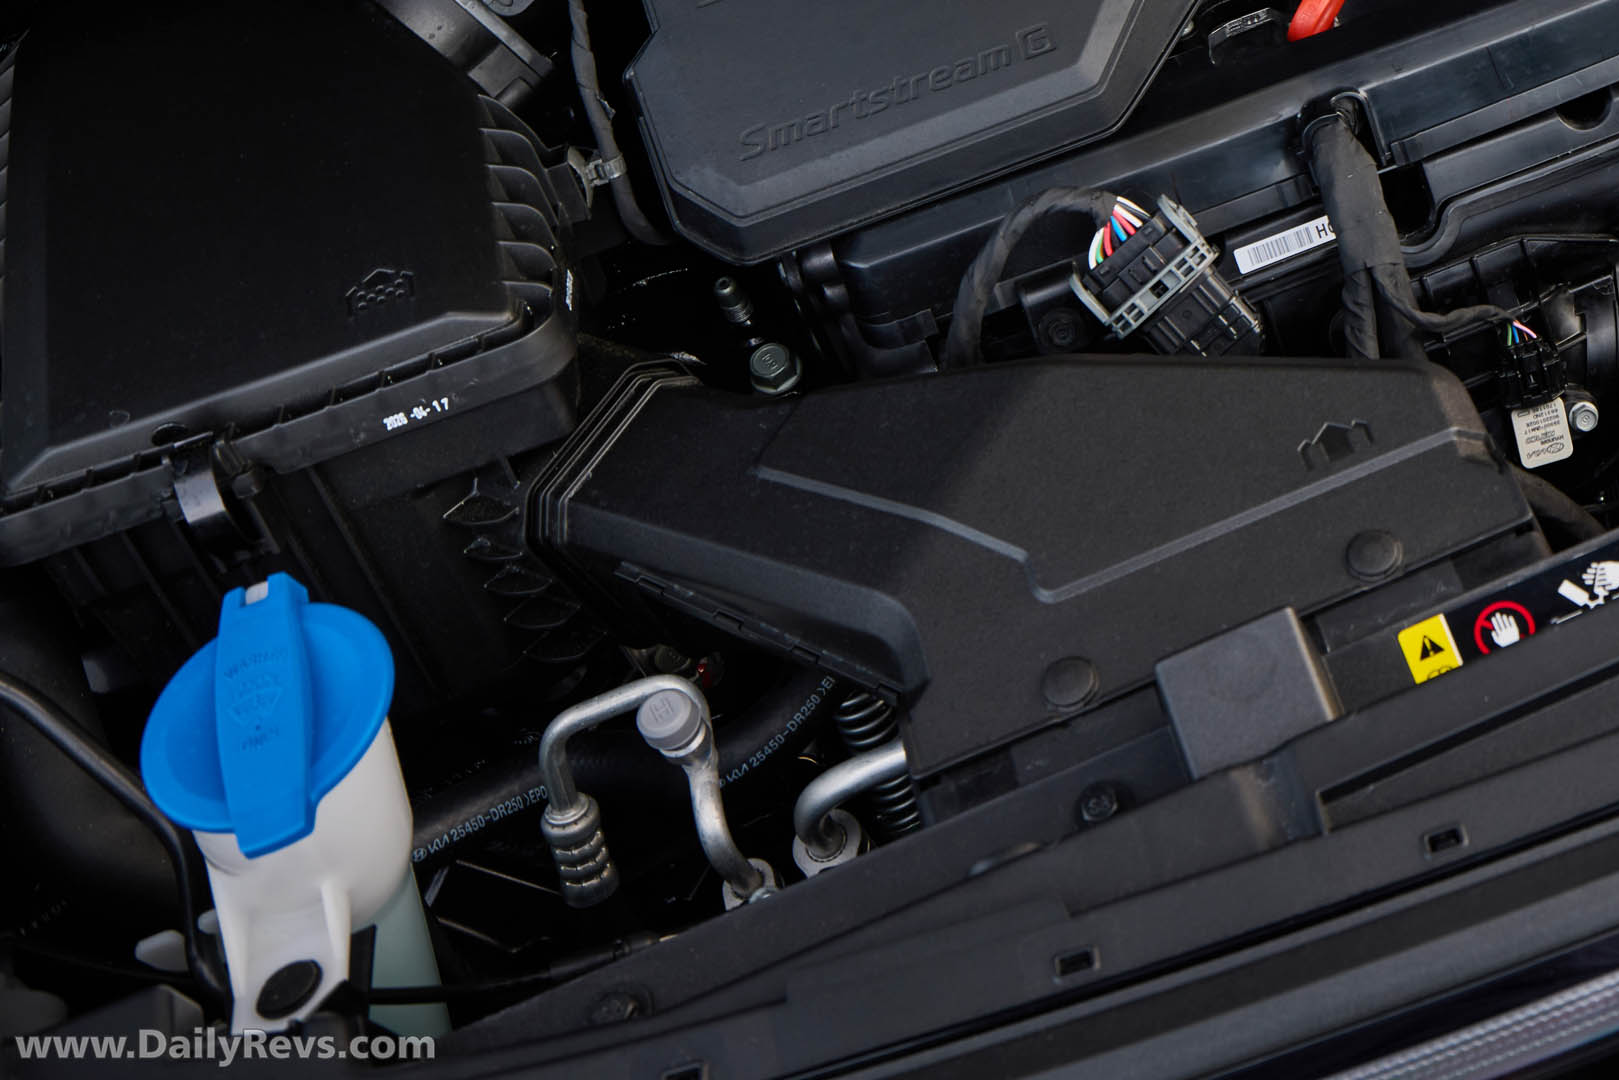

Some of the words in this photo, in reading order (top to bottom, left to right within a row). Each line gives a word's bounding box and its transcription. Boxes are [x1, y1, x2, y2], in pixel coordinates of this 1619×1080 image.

[737, 43, 1011, 162] Smartstream
[748, 693, 821, 768] 25450-DR250
[449, 794, 523, 842] 25450-DR250
